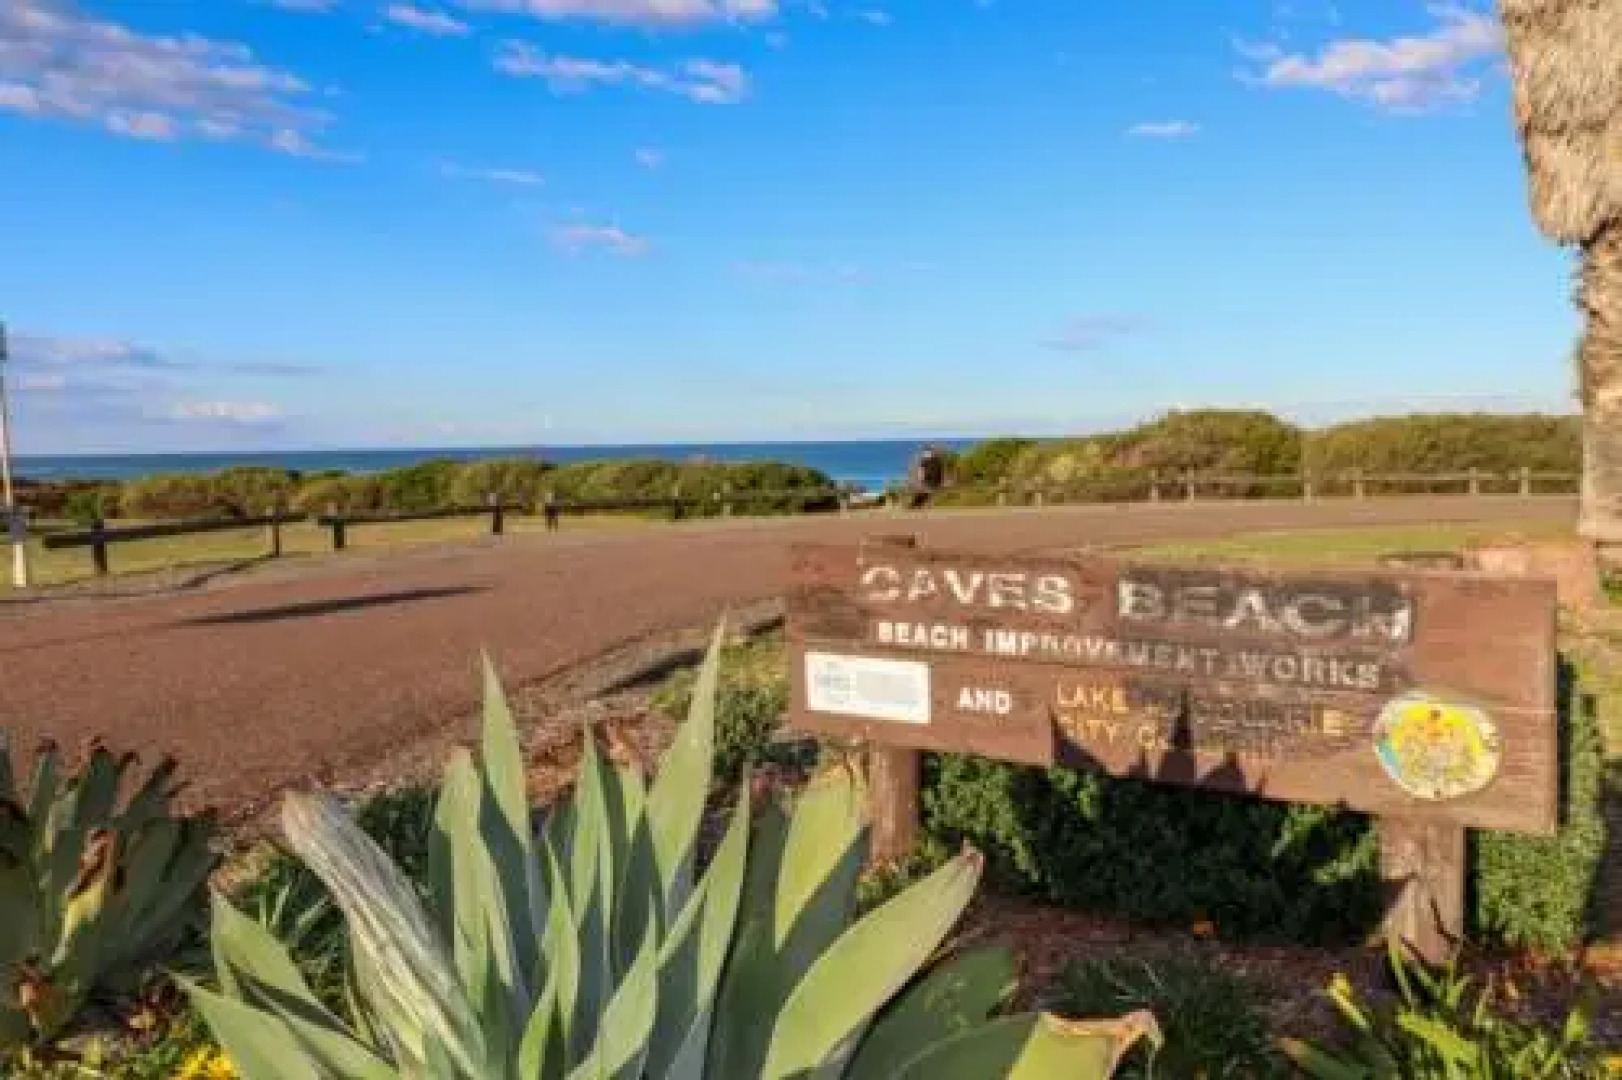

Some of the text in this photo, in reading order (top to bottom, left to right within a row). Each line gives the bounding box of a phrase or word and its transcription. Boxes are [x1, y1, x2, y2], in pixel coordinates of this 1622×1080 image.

[860, 566, 1411, 638] CAVES BEACH
[877, 622, 969, 651] BEACH
[1235, 652, 1380, 688] WORKS
[957, 687, 1012, 714] AND
[1056, 682, 1128, 713] LAKE
